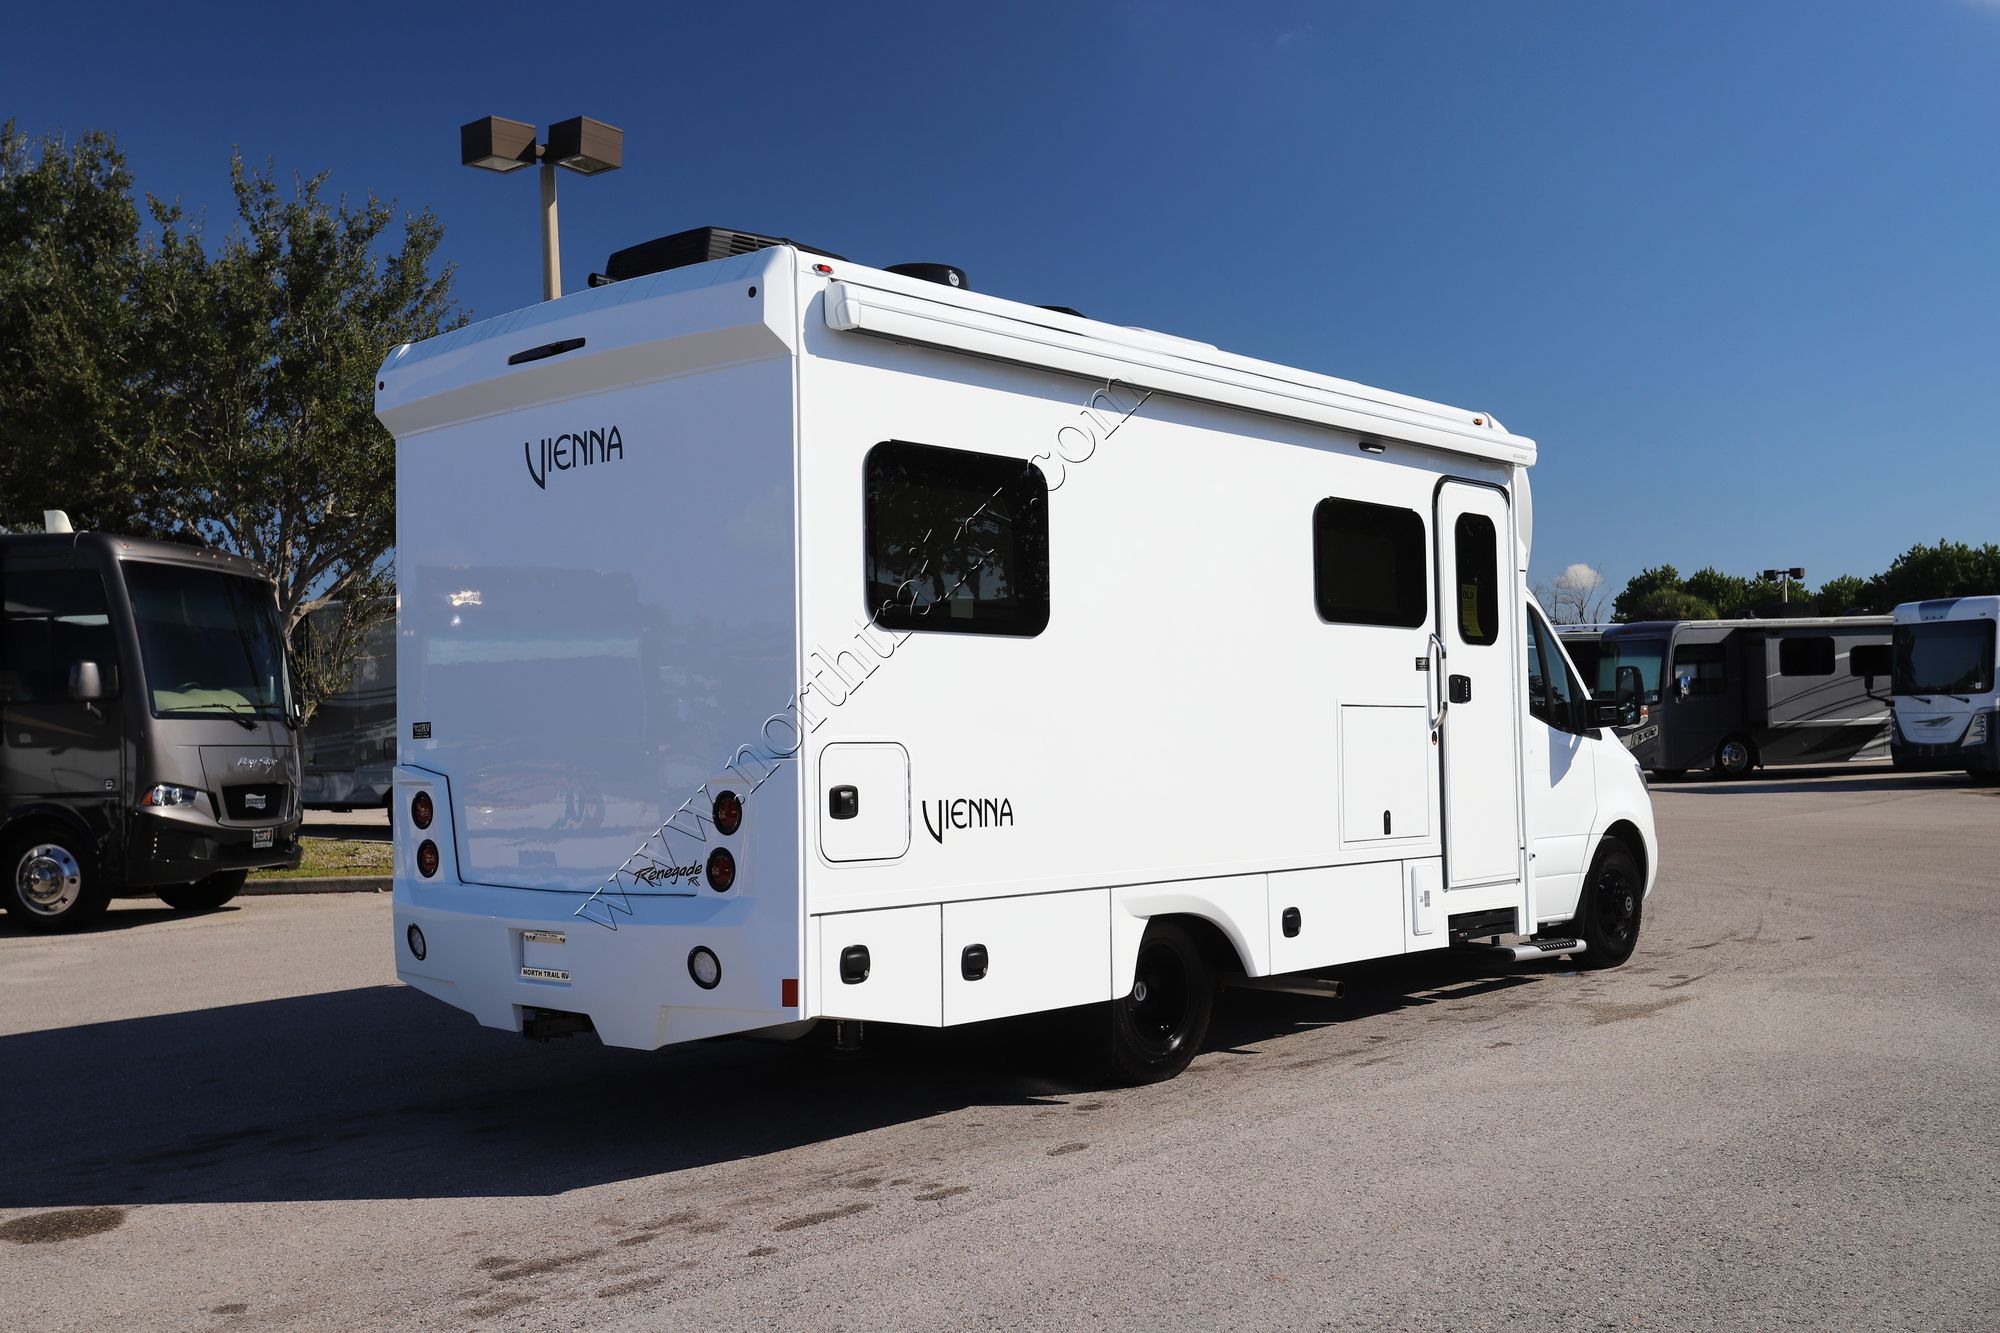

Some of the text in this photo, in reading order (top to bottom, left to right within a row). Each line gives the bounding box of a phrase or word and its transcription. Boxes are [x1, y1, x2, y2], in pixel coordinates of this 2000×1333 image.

[524, 424, 624, 490] VIENNA
[922, 798, 1014, 844] VIENNA
[633, 859, 703, 888] Renegade
[523, 969, 543, 977] NORTH
[544, 970, 560, 979] TRAIL
